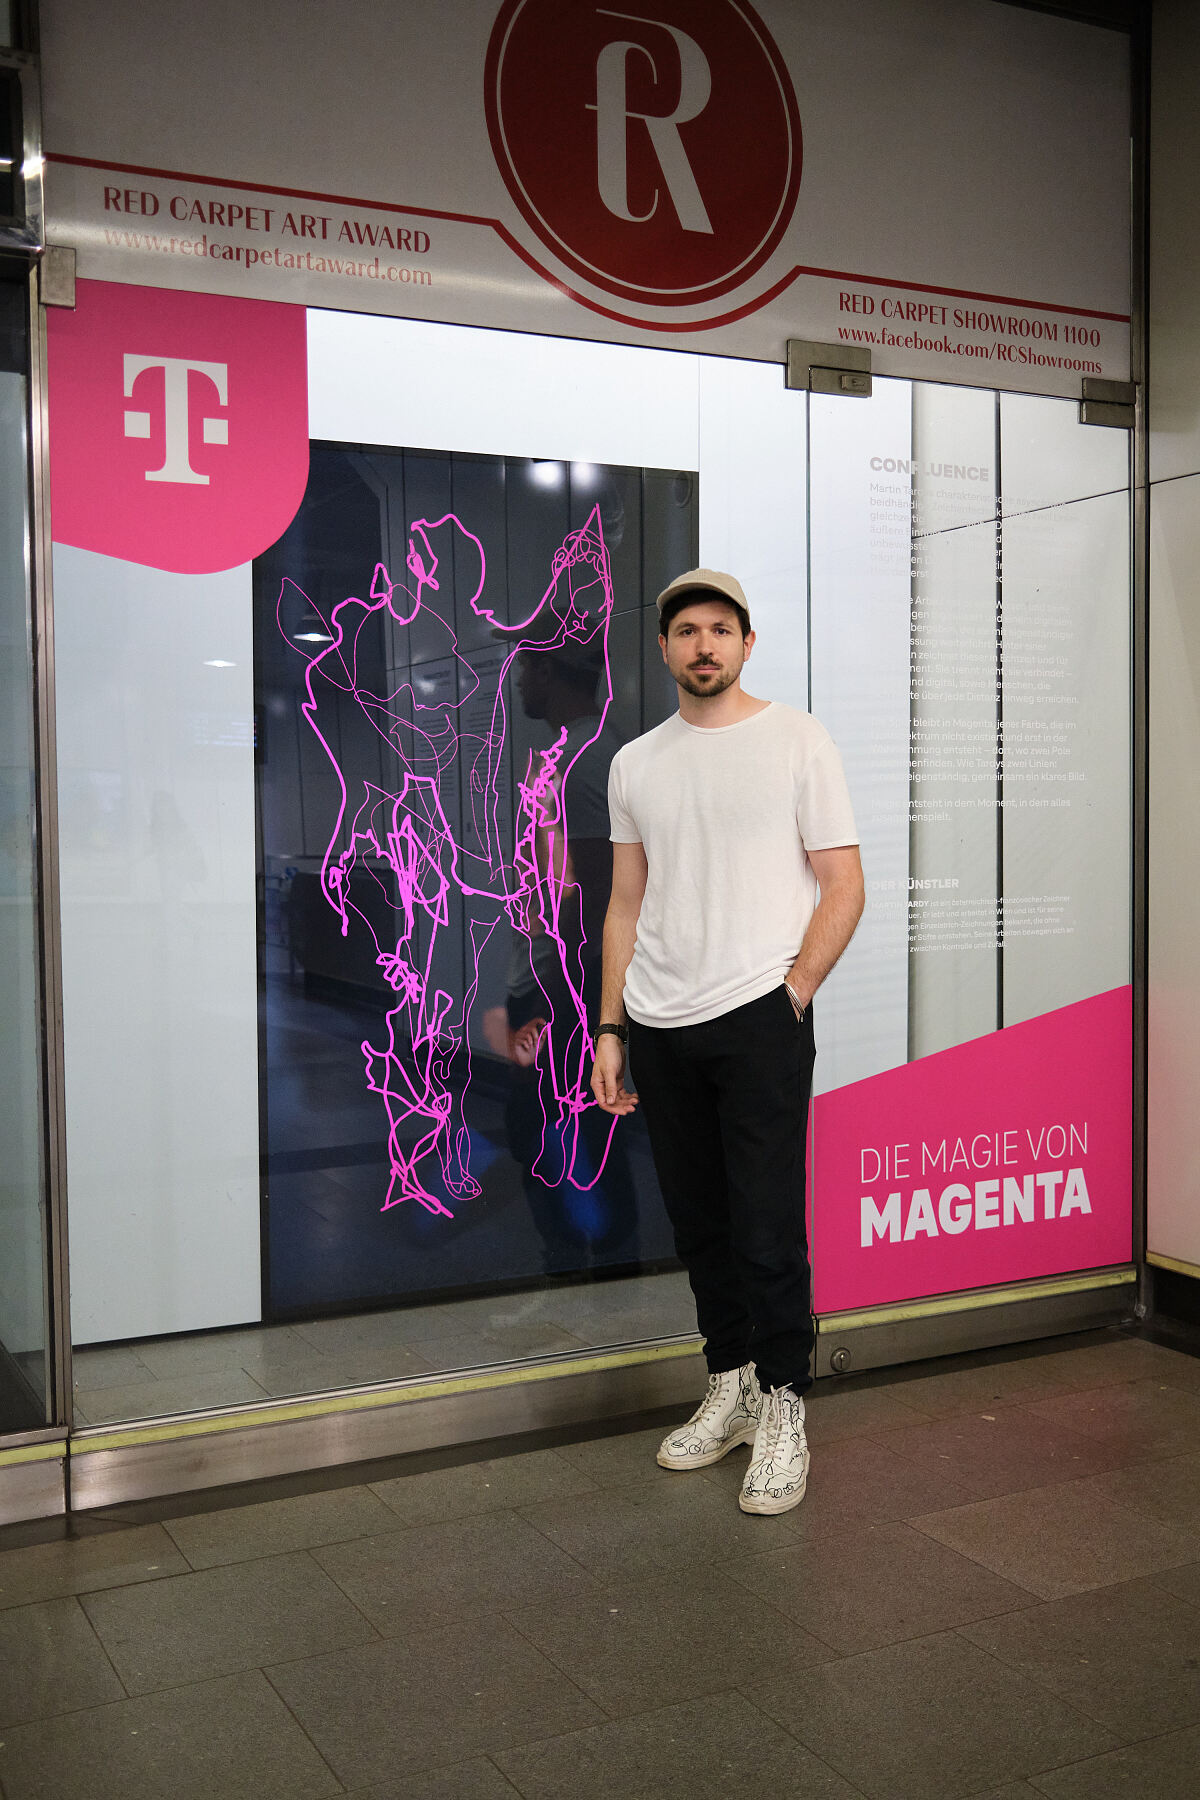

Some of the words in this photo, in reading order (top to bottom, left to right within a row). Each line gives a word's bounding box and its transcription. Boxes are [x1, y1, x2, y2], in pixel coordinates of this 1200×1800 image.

[103, 186, 159, 216] RED
[169, 196, 275, 232] CARPET
[281, 212, 332, 240] ART
[338, 220, 431, 254] AWARD
[103, 228, 433, 286] www.redcarpetartaward.com
[839, 292, 875, 315] RED
[881, 298, 949, 326] CARPET
[953, 308, 1058, 342] SHOWROOM
[1063, 325, 1101, 348] 1100
[837, 327, 1103, 375] www.facebook.com/RCShowrooms
[123, 353, 229, 486] T
[870, 457, 989, 482] CONFLUENCE
[913, 717, 942, 728] bleibt
[941, 732, 965, 742] nicht
[956, 759, 974, 769] Wie
[1025, 772, 1039, 782] ein
[906, 800, 943, 809] ntsteht
[954, 799, 975, 809] dem
[977, 798, 1017, 809] Moment,
[1029, 798, 1049, 808] dem
[861, 1143, 909, 1183] DIE
[921, 1129, 1018, 1176] MAGIE
[1026, 1121, 1088, 1161] VON
[860, 1167, 1092, 1248] MAGENTA
